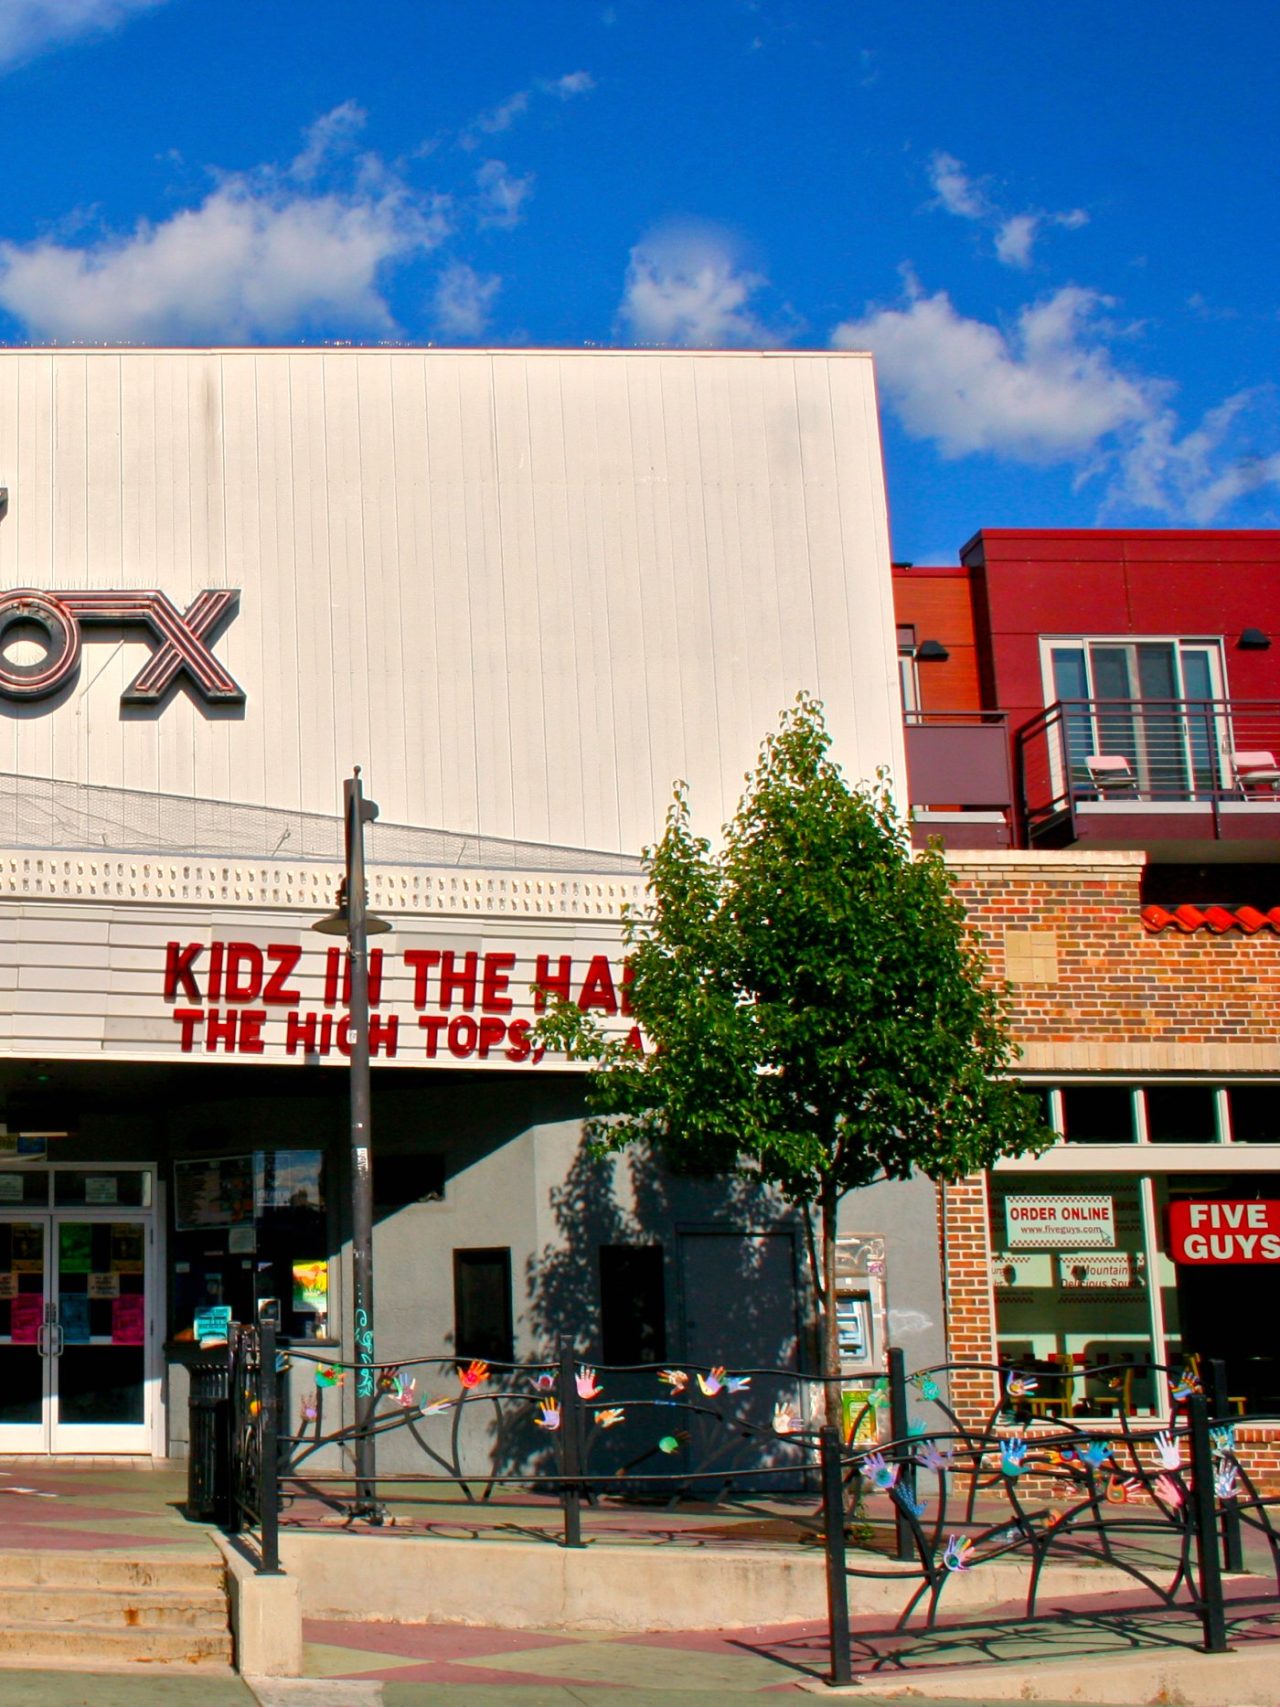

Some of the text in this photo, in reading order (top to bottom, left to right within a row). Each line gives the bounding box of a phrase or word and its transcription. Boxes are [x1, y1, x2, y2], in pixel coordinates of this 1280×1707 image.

[164, 941, 302, 1006] KIDZ
[324, 947, 384, 1009] IN
[404, 949, 516, 1015] THE
[173, 1009, 266, 1053] THE
[419, 1015, 545, 1065] TOPS,
[1010, 1207, 1056, 1220] ORDER
[1061, 1207, 1110, 1220] ONLINE
[1189, 1204, 1269, 1228] FIVE
[1021, 1225, 1102, 1235] www.fiveguys.com
[1183, 1234, 1280, 1259] GUYS
[1082, 1264, 1129, 1276] Mountain
